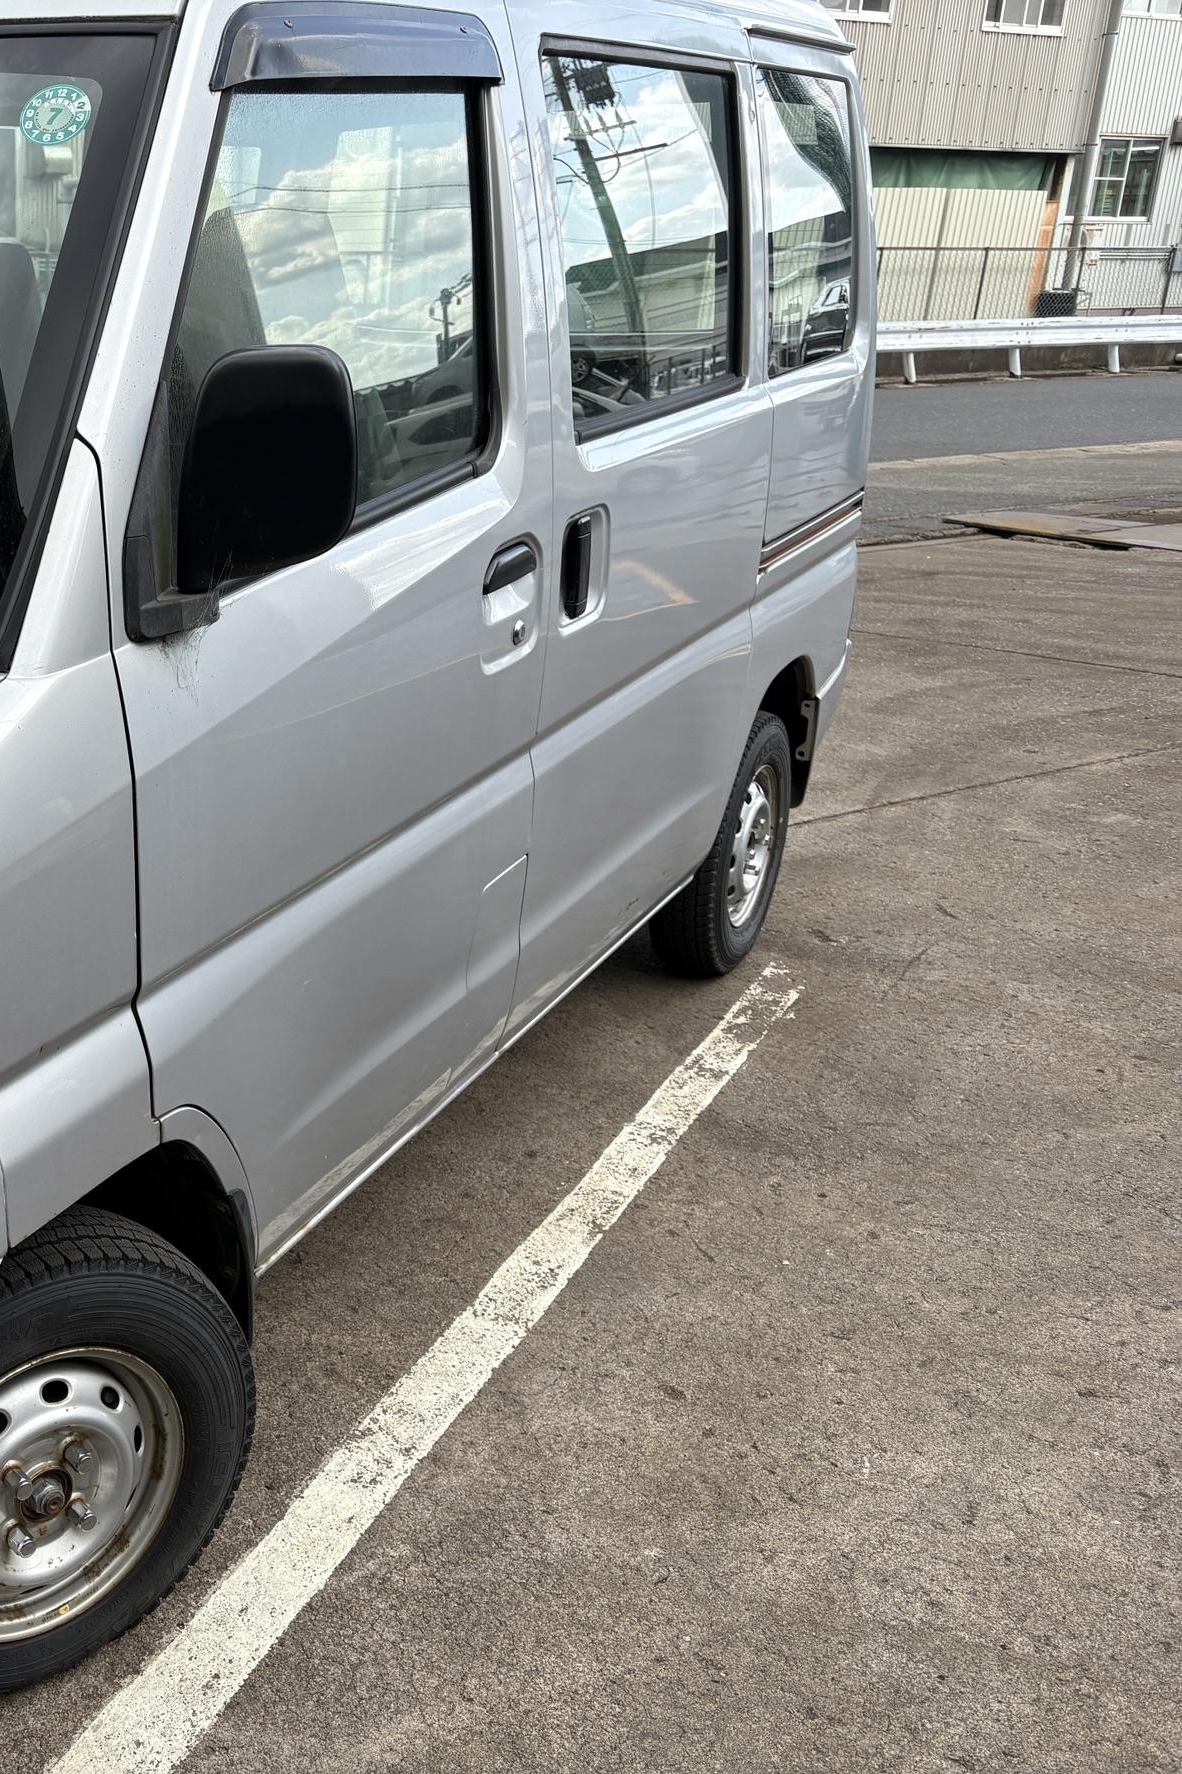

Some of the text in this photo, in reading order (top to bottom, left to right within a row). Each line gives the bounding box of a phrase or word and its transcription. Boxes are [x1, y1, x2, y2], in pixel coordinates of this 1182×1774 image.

[71, 92, 77, 100] 1
[32, 99, 42, 107] 10
[26, 109, 34, 117] 9
[46, 107, 63, 125] 7
[75, 113, 84, 121] 3
[68, 124, 77, 132] 4
[31, 130, 40, 138] 7
[43, 133, 51, 141] 6
[56, 132, 65, 140] 5
